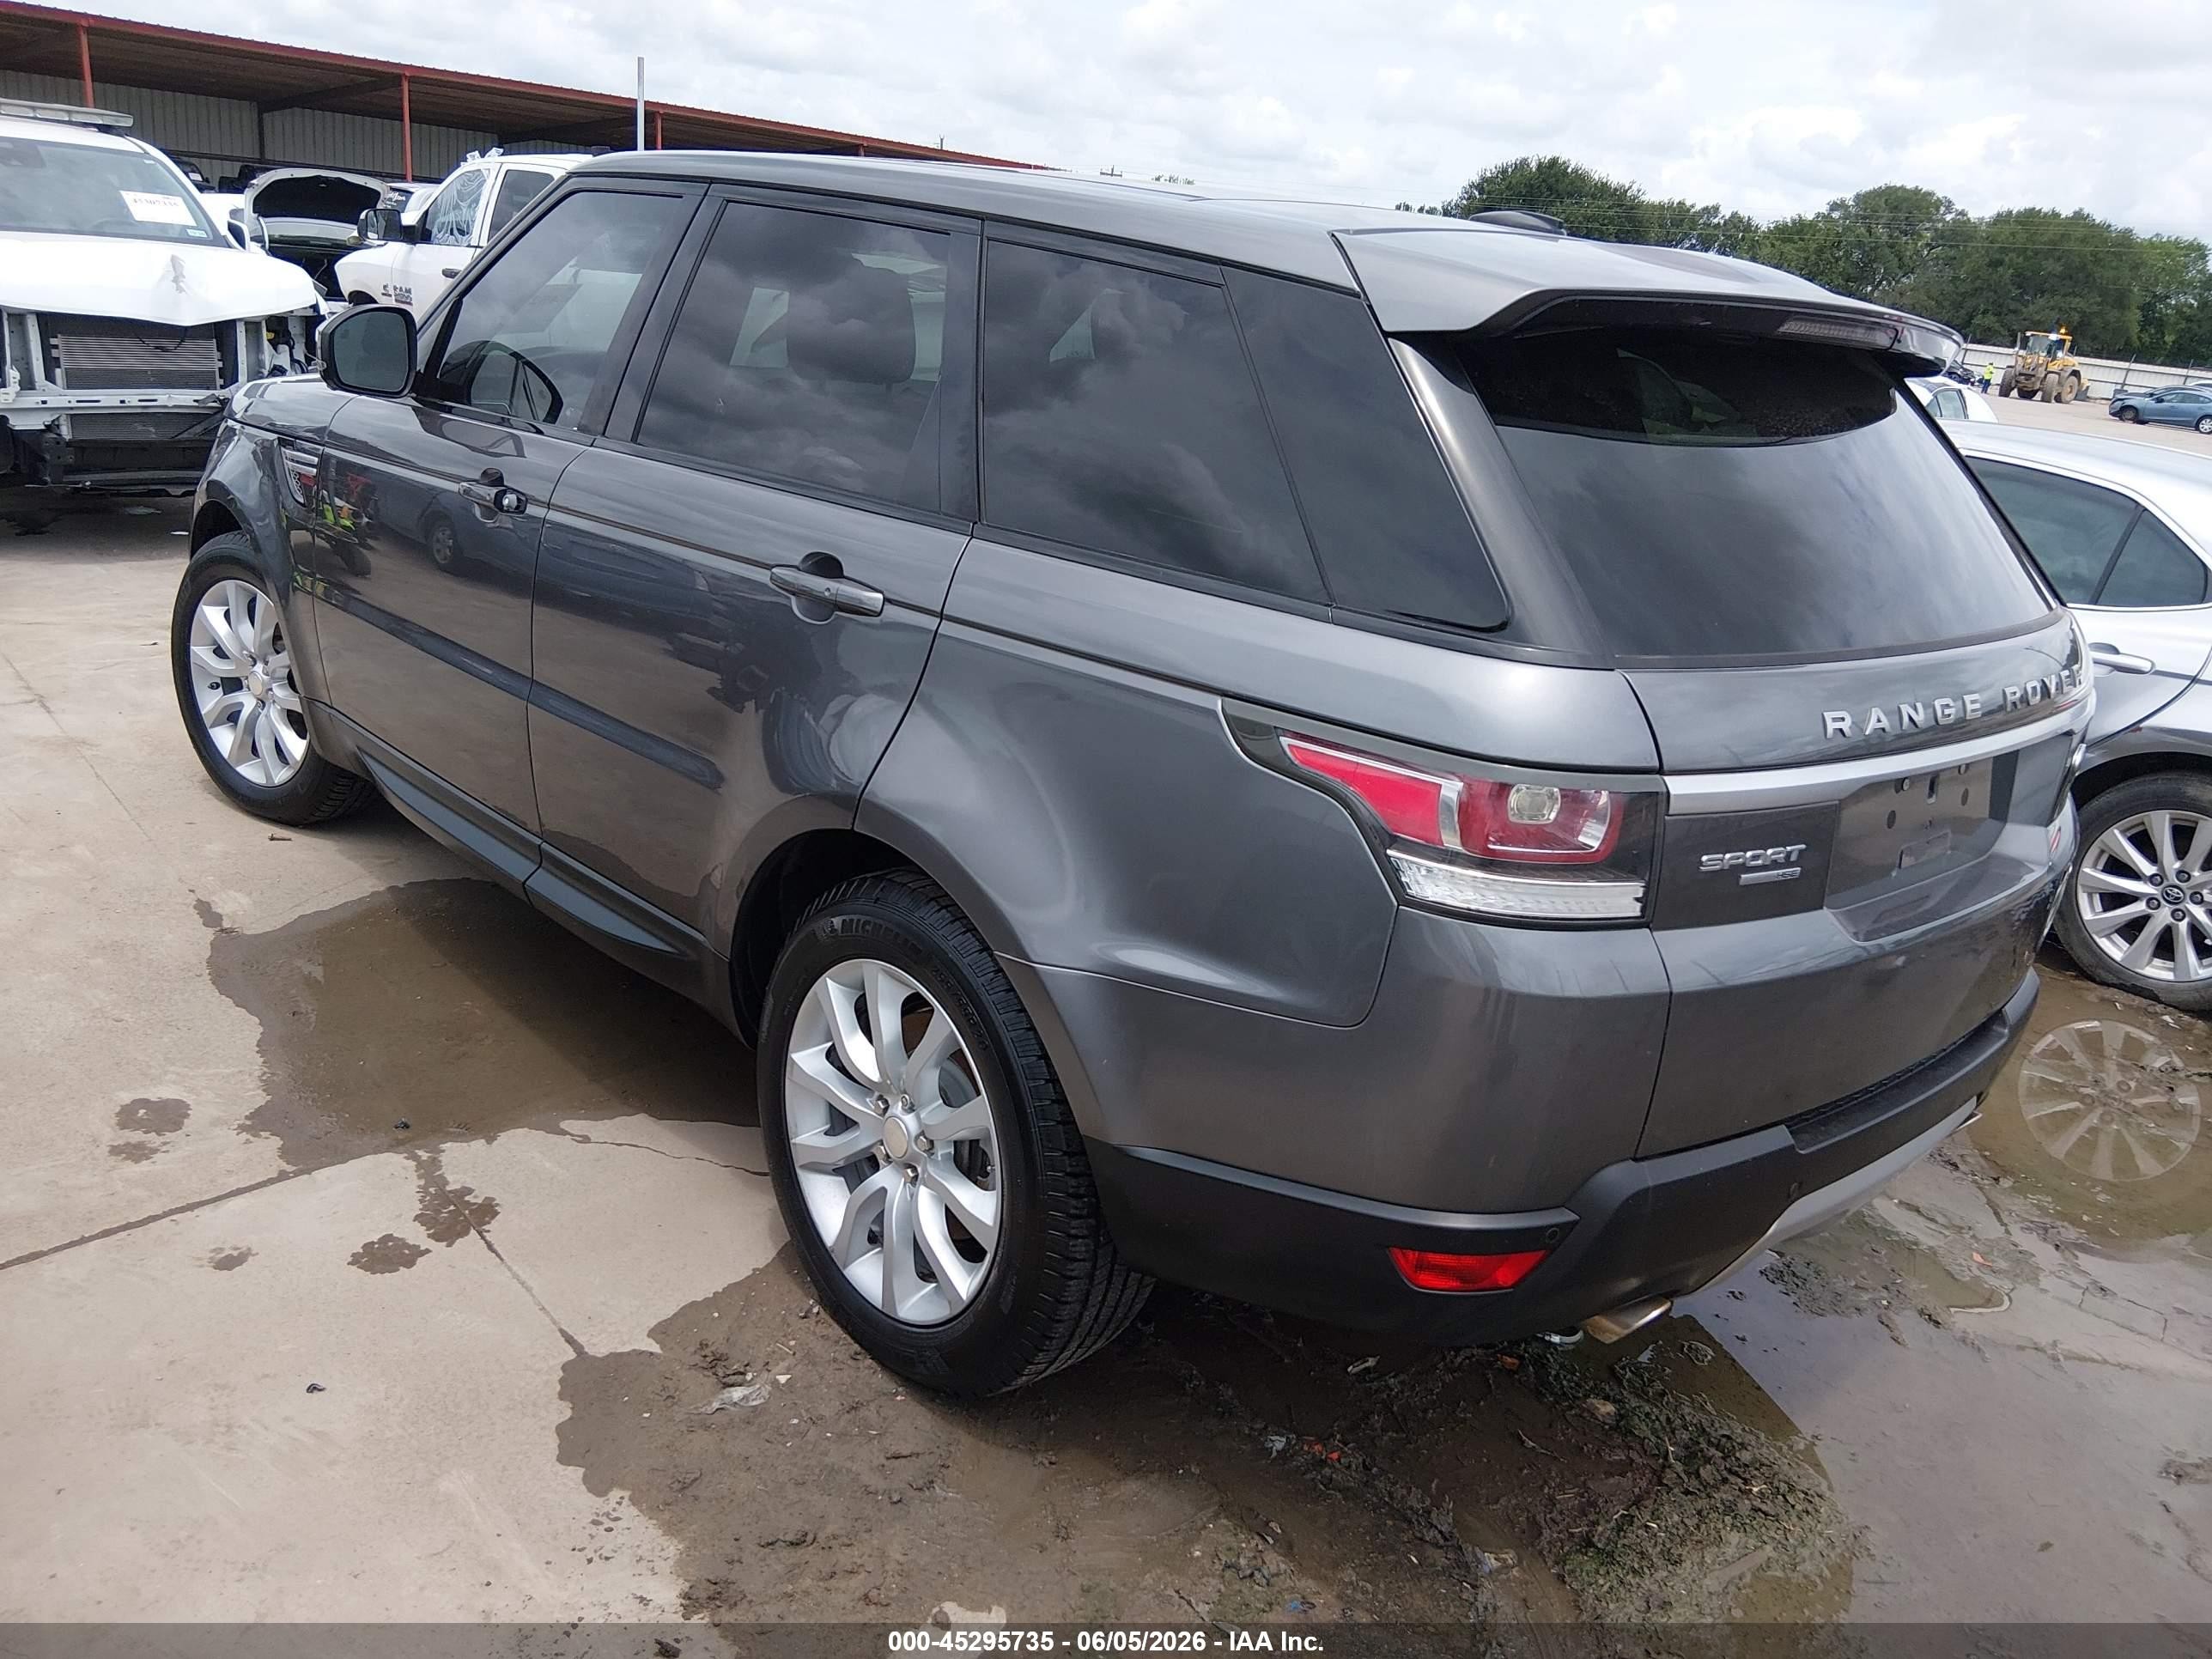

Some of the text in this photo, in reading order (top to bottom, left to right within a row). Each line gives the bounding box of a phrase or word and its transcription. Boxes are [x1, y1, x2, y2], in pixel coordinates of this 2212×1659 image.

[393, 284, 412, 295] RAM
[1822, 664, 2083, 739] RANGE ROVER
[1699, 843, 1808, 872] SPORT
[1776, 869, 1801, 880] HSE
